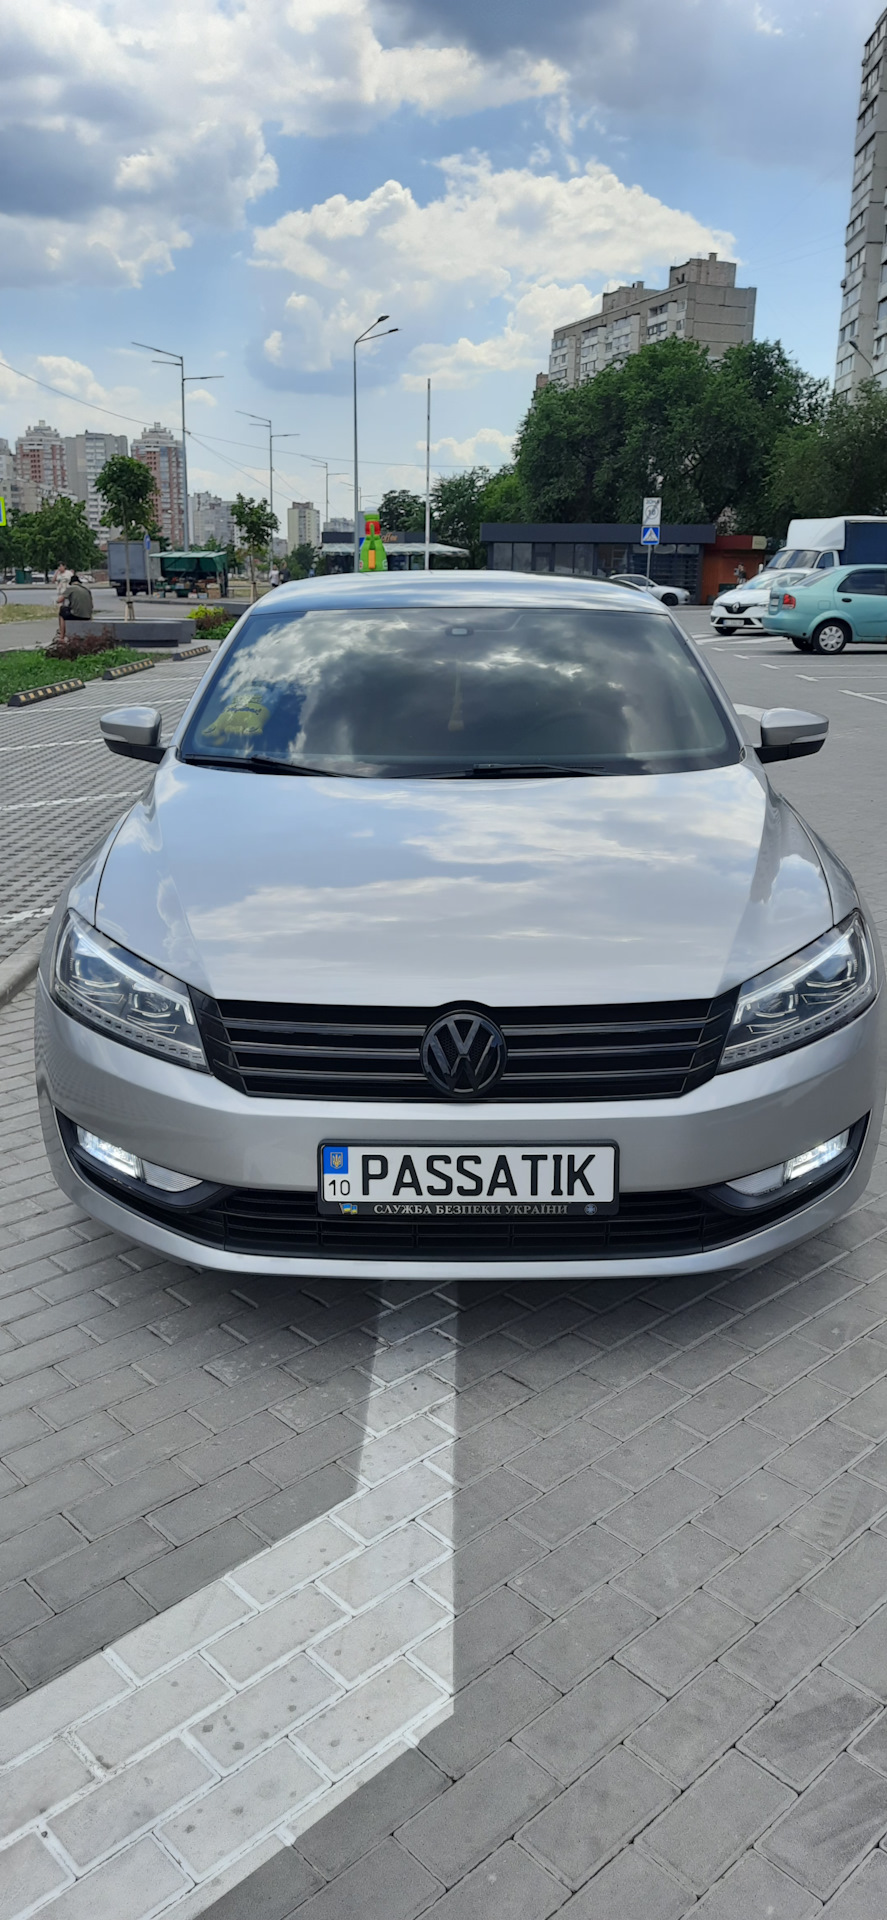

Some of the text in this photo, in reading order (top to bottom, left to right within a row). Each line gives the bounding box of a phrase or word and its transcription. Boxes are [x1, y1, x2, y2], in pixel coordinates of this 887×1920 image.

[381, 532, 398, 542] offee
[361, 1154, 596, 1196] PASSATIK
[328, 1179, 350, 1196] 10
[373, 1203, 568, 1215] СЛУЖБА БЕЗПЕКИ УКРАЇНИ
